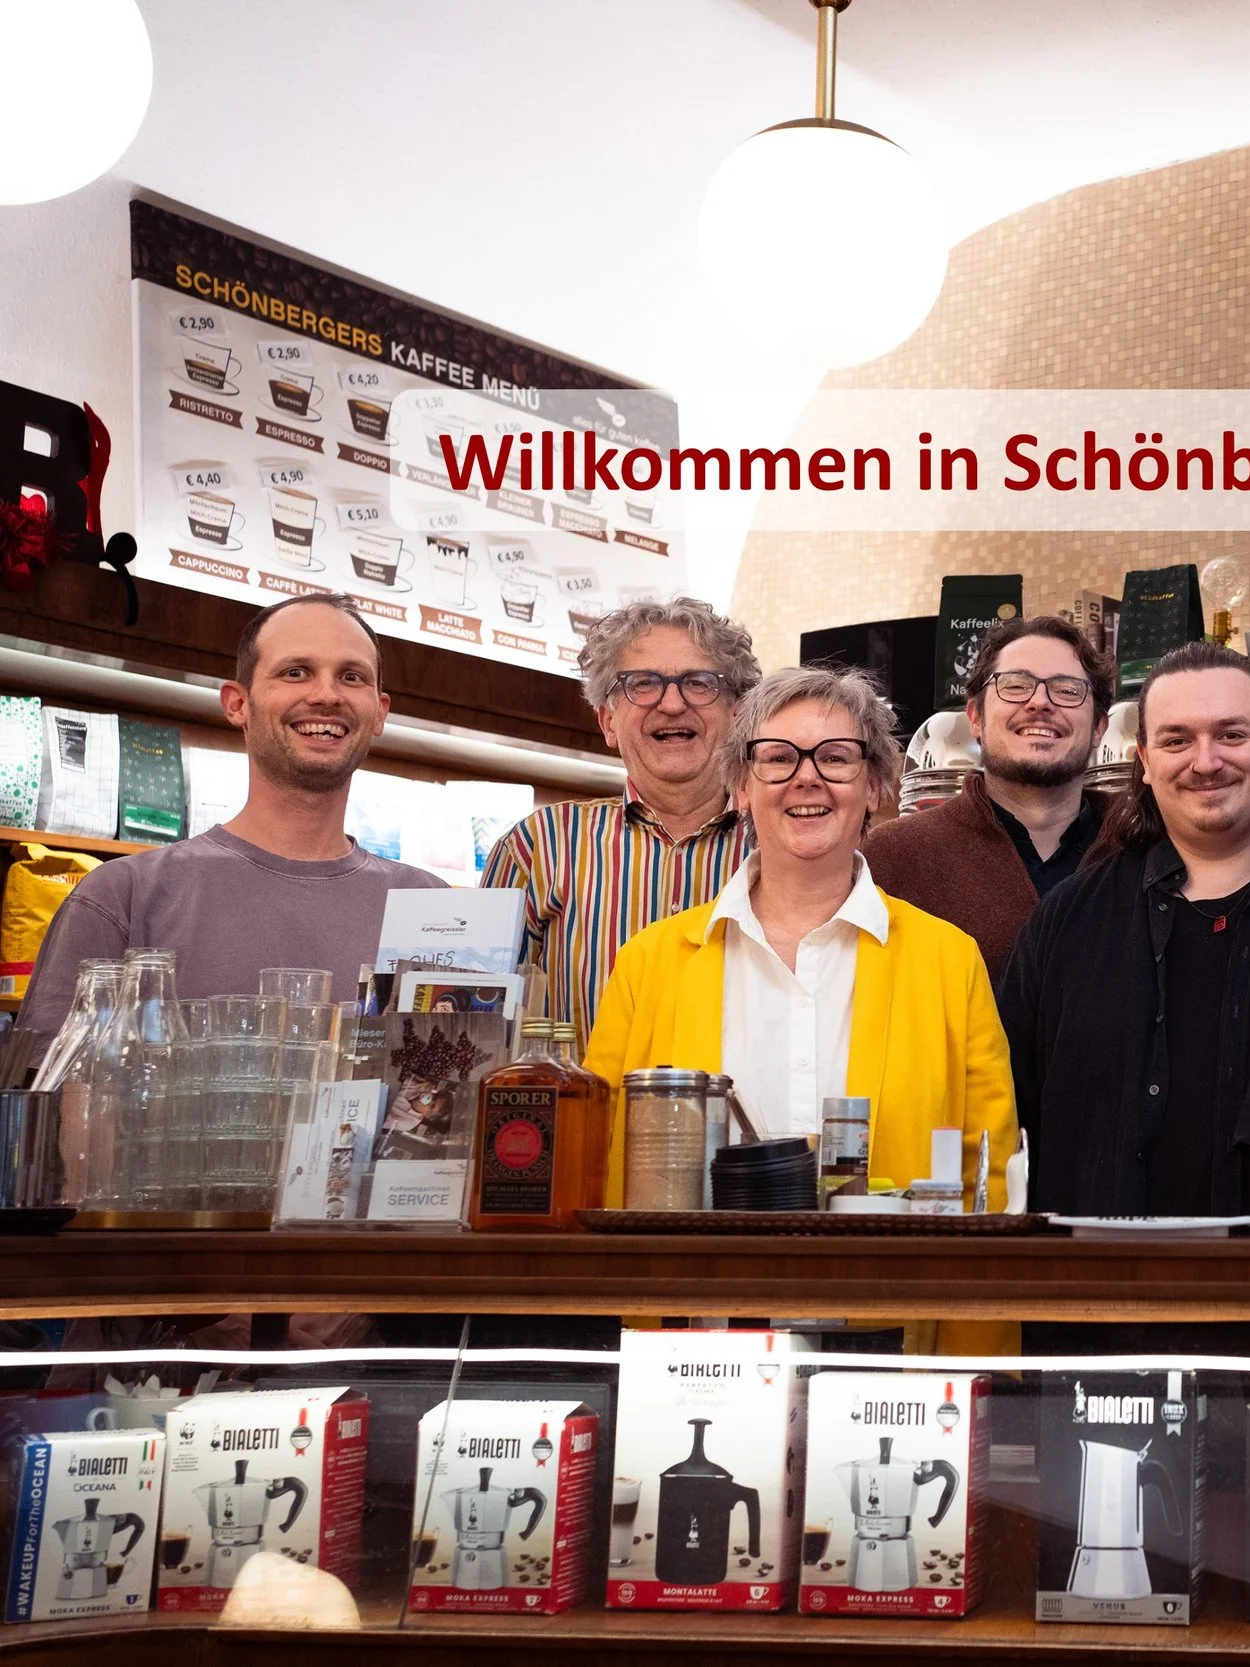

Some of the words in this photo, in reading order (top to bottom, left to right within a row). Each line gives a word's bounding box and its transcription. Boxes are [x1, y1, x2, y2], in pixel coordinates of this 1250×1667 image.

[190, 317, 214, 331] 2,90
[175, 264, 383, 356] SCHÖNBERGERS
[391, 340, 475, 389] KAFFEE
[482, 373, 541, 411] MENÜ
[278, 347, 301, 362] 2,90
[357, 374, 379, 387] 4,20
[179, 398, 234, 423] RISTRETTO
[265, 424, 315, 448] ESPRESSO
[353, 451, 388, 470] DOPPIO
[195, 473, 222, 487] 4,40
[280, 471, 304, 484] 4,90
[498, 491, 532, 507] KLEINER
[357, 508, 379, 521] 5,10
[497, 500, 535, 518] BRAUNER
[559, 509, 601, 528] ESPRESSO
[624, 534, 660, 552] MELANGE
[504, 551, 525, 563] 4,90
[177, 554, 244, 580] CAPPUCCINO
[265, 577, 297, 593] CAFFÈ
[375, 603, 402, 618] WHITE
[438, 612, 464, 627] LATTE
[426, 620, 477, 642] MACCHIATO
[497, 633, 516, 647] CON
[490, 1091, 552, 1106] SPORER
[387, 1194, 450, 1206] SERVICE
[73, 1483, 117, 1492] OCEANA
[473, 1595, 509, 1603] EXPRESS
[663, 1587, 718, 1596] MONTALATTE
[876, 1595, 914, 1604] EXPRESS
[1092, 1602, 1126, 1610] VENUS
[49, 1607, 74, 1615] MOKA
[76, 1605, 111, 1613] EXPRESS
